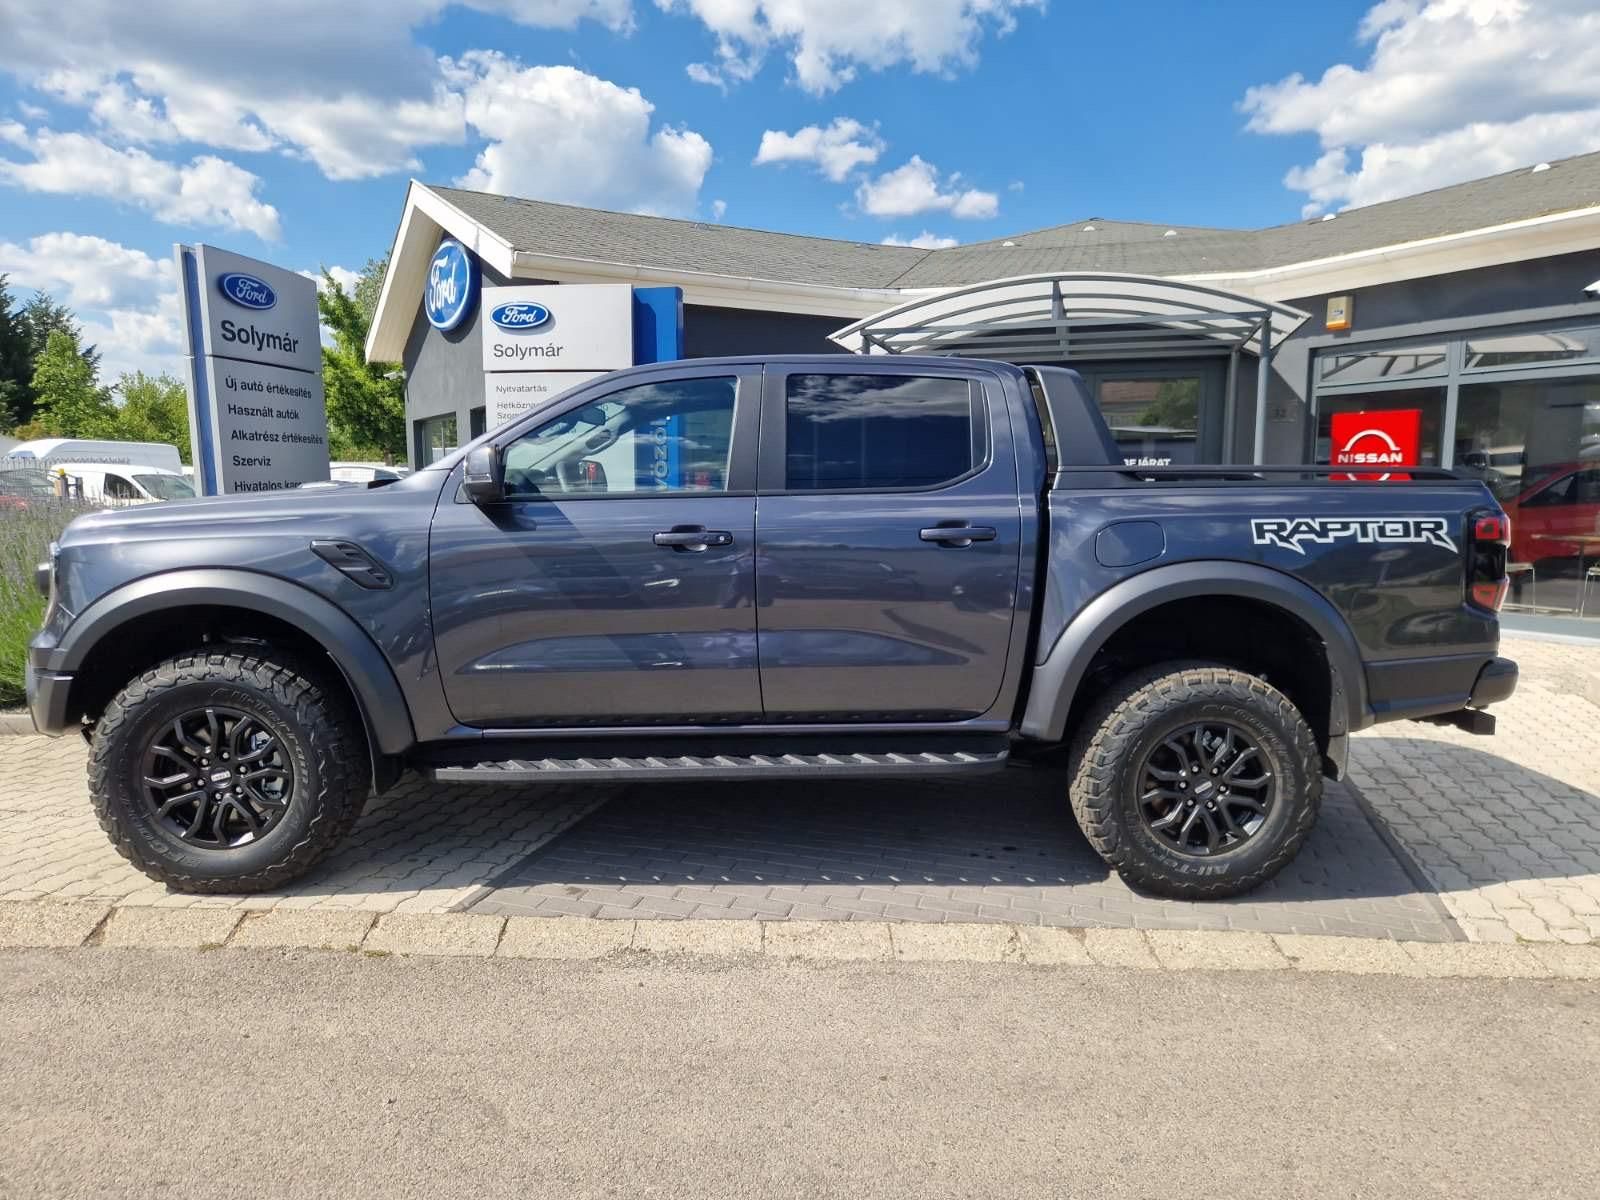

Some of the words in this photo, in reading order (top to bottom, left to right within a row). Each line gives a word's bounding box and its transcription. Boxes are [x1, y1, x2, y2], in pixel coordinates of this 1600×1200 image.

[236, 278, 267, 304] Ford
[428, 254, 457, 313] Ford
[501, 305, 537, 323] Ford
[221, 319, 299, 353] Solymár
[493, 342, 564, 360] Solymár
[225, 375, 237, 391] Új
[240, 380, 264, 392] autó
[266, 382, 312, 399] értékesítés
[228, 403, 274, 418] Használt
[276, 407, 300, 420] autók
[231, 429, 280, 443] Alkatrész
[232, 454, 272, 467] Szerviz
[1337, 451, 1403, 463] NISSAN
[234, 480, 282, 492] Hivatalos
[1250, 517, 1458, 555] RAPTOR
